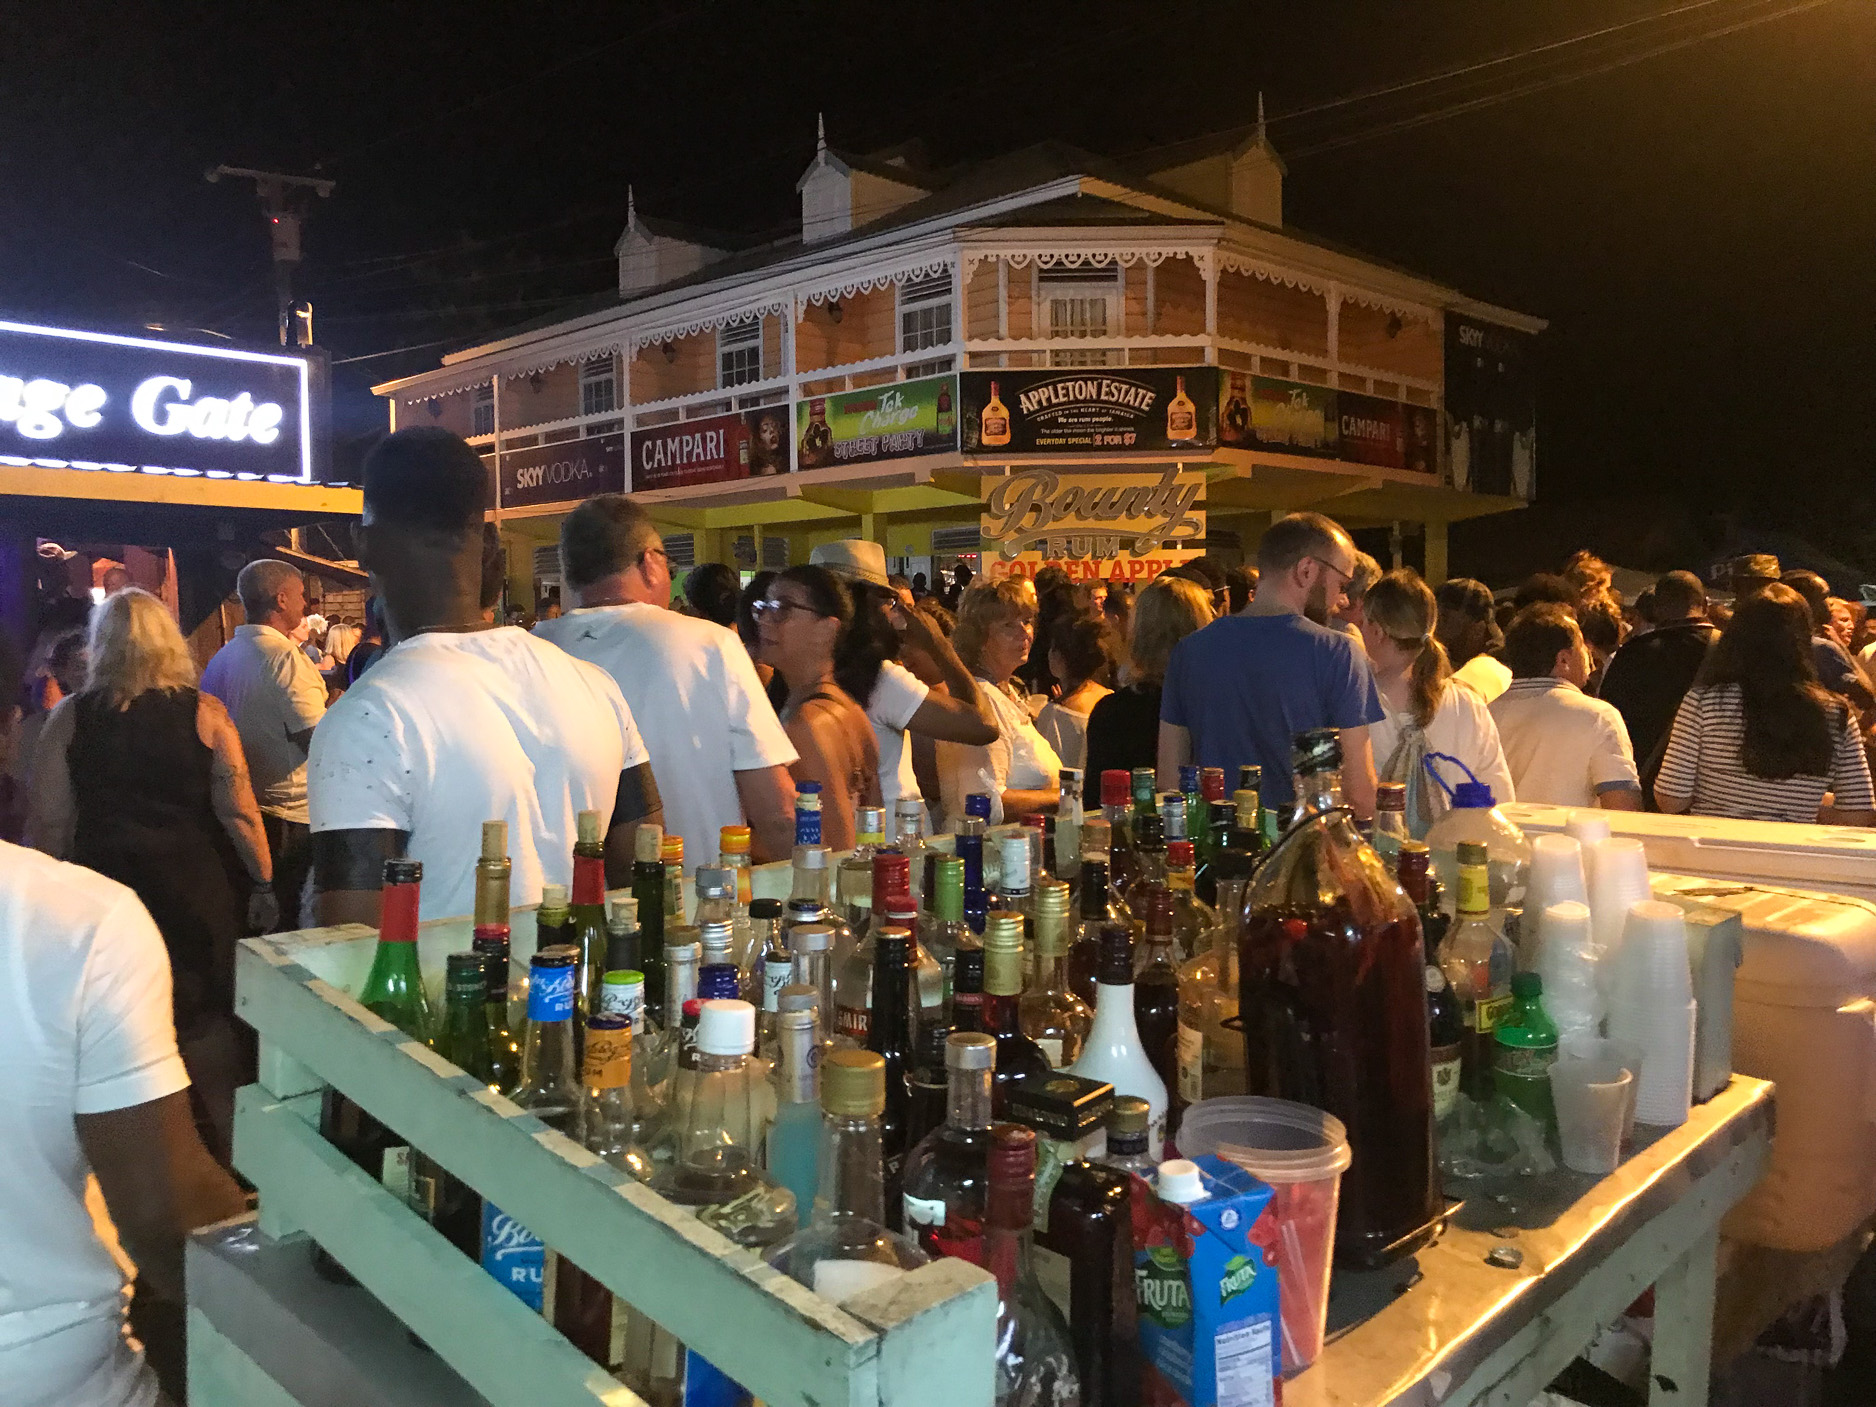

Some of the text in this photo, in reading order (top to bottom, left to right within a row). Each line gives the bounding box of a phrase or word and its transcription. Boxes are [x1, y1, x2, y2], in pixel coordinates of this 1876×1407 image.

[131, 375, 283, 444] Gate
[1019, 379, 1157, 415] APPLETON ESTATE
[1036, 437, 1066, 446] EVERYDAY
[1067, 436, 1092, 445] SPECIAL
[1094, 434, 1102, 446] 2
[1103, 434, 1122, 446] FOR
[1341, 414, 1391, 442] CAMPARI
[642, 428, 725, 470] CAMPARI
[833, 434, 880, 460] STREET
[981, 468, 1204, 546] Bounty
[1046, 536, 1120, 558] RUM
[1134, 1267, 1191, 1311] FRUTA
[1219, 1265, 1257, 1298] FRUTA
